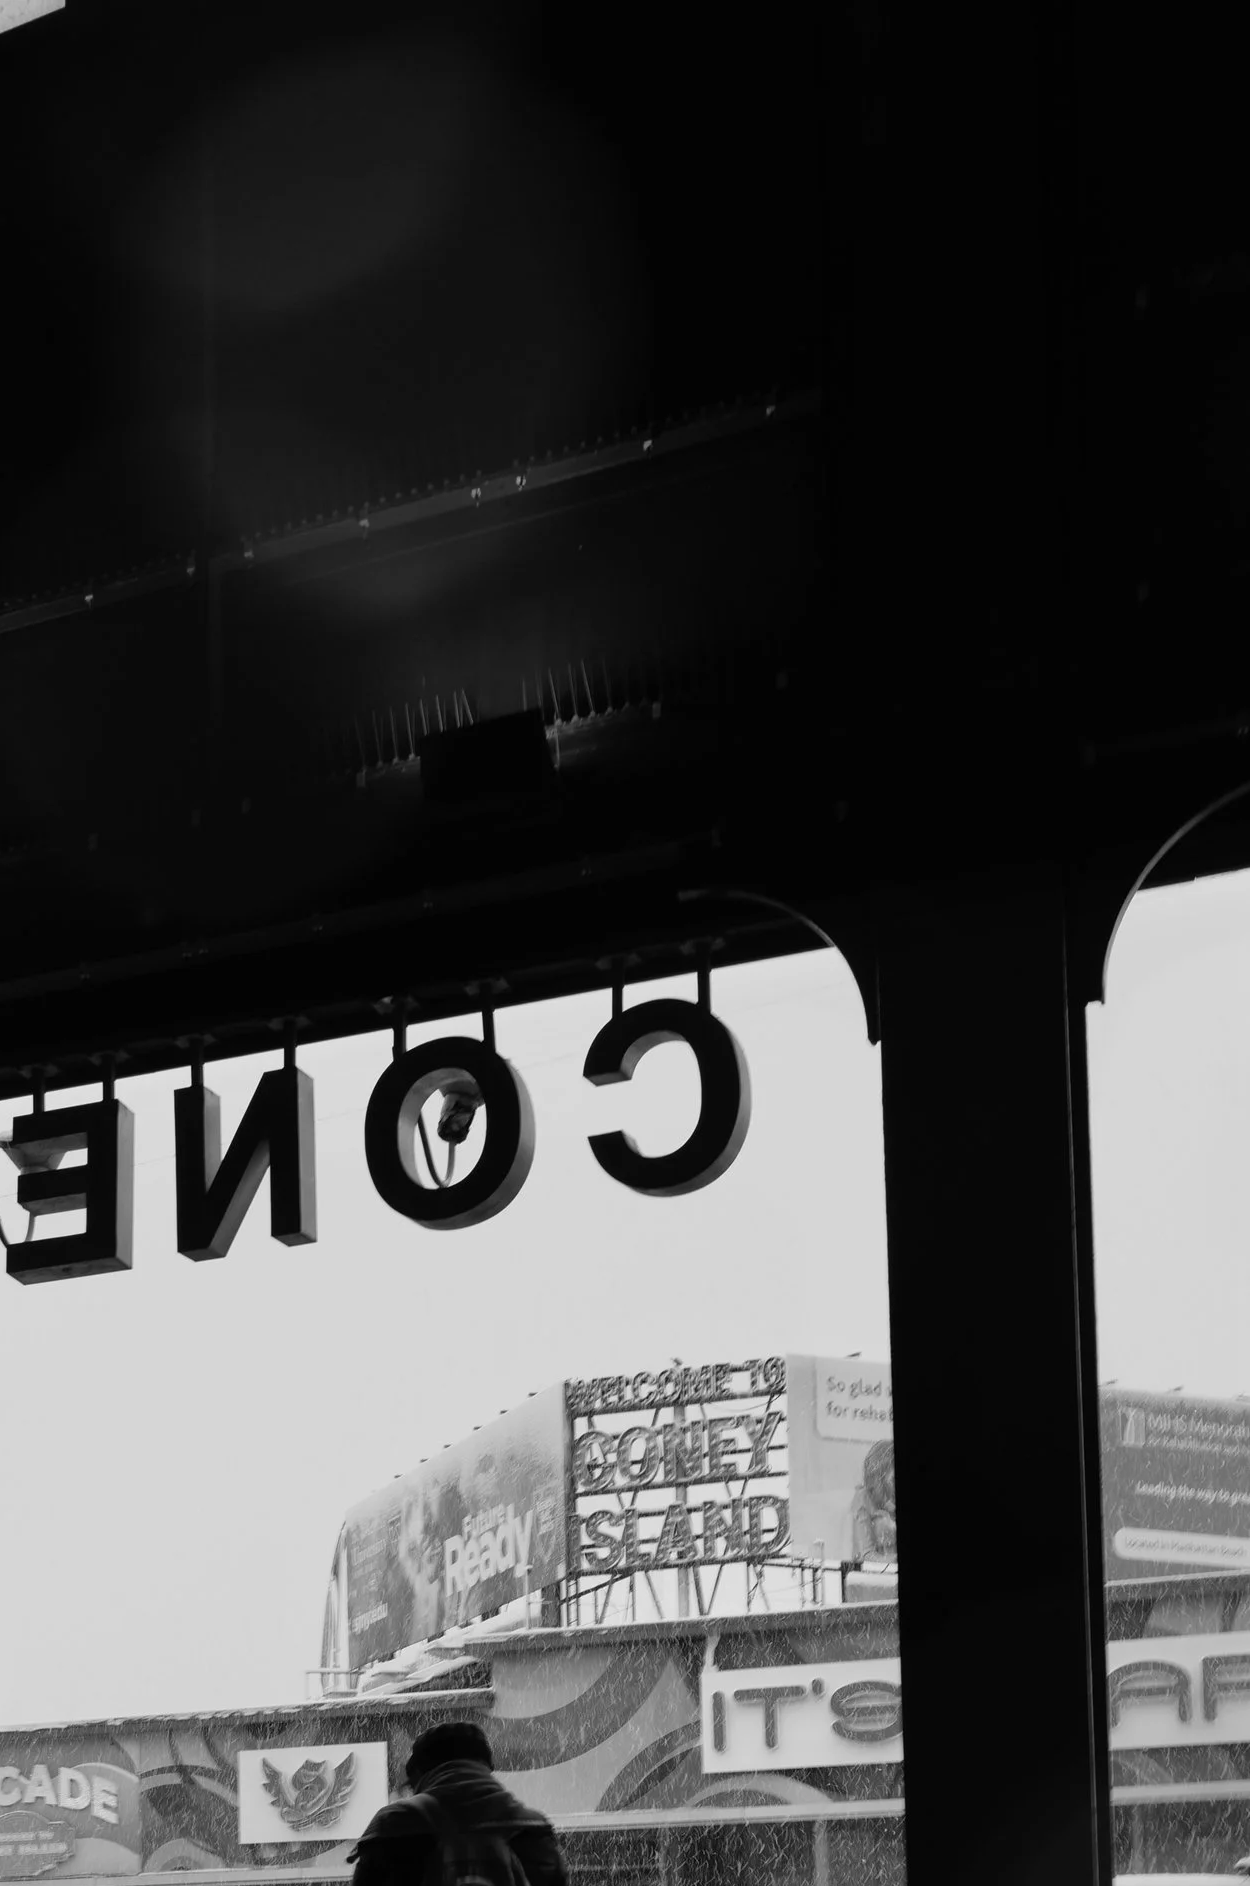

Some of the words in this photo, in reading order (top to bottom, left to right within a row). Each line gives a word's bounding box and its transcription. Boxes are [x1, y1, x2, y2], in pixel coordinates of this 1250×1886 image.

[565, 1363, 730, 1403] WELCOME
[747, 1356, 787, 1395] TO
[826, 1400, 849, 1418] for
[827, 1376, 846, 1393] So
[850, 1378, 882, 1400] glad
[574, 1411, 783, 1492] CONEY
[444, 1503, 534, 1598] Ready
[461, 1503, 507, 1538] Future
[565, 1496, 792, 1575] ISLAND
[711, 1677, 904, 1753] IT'S
